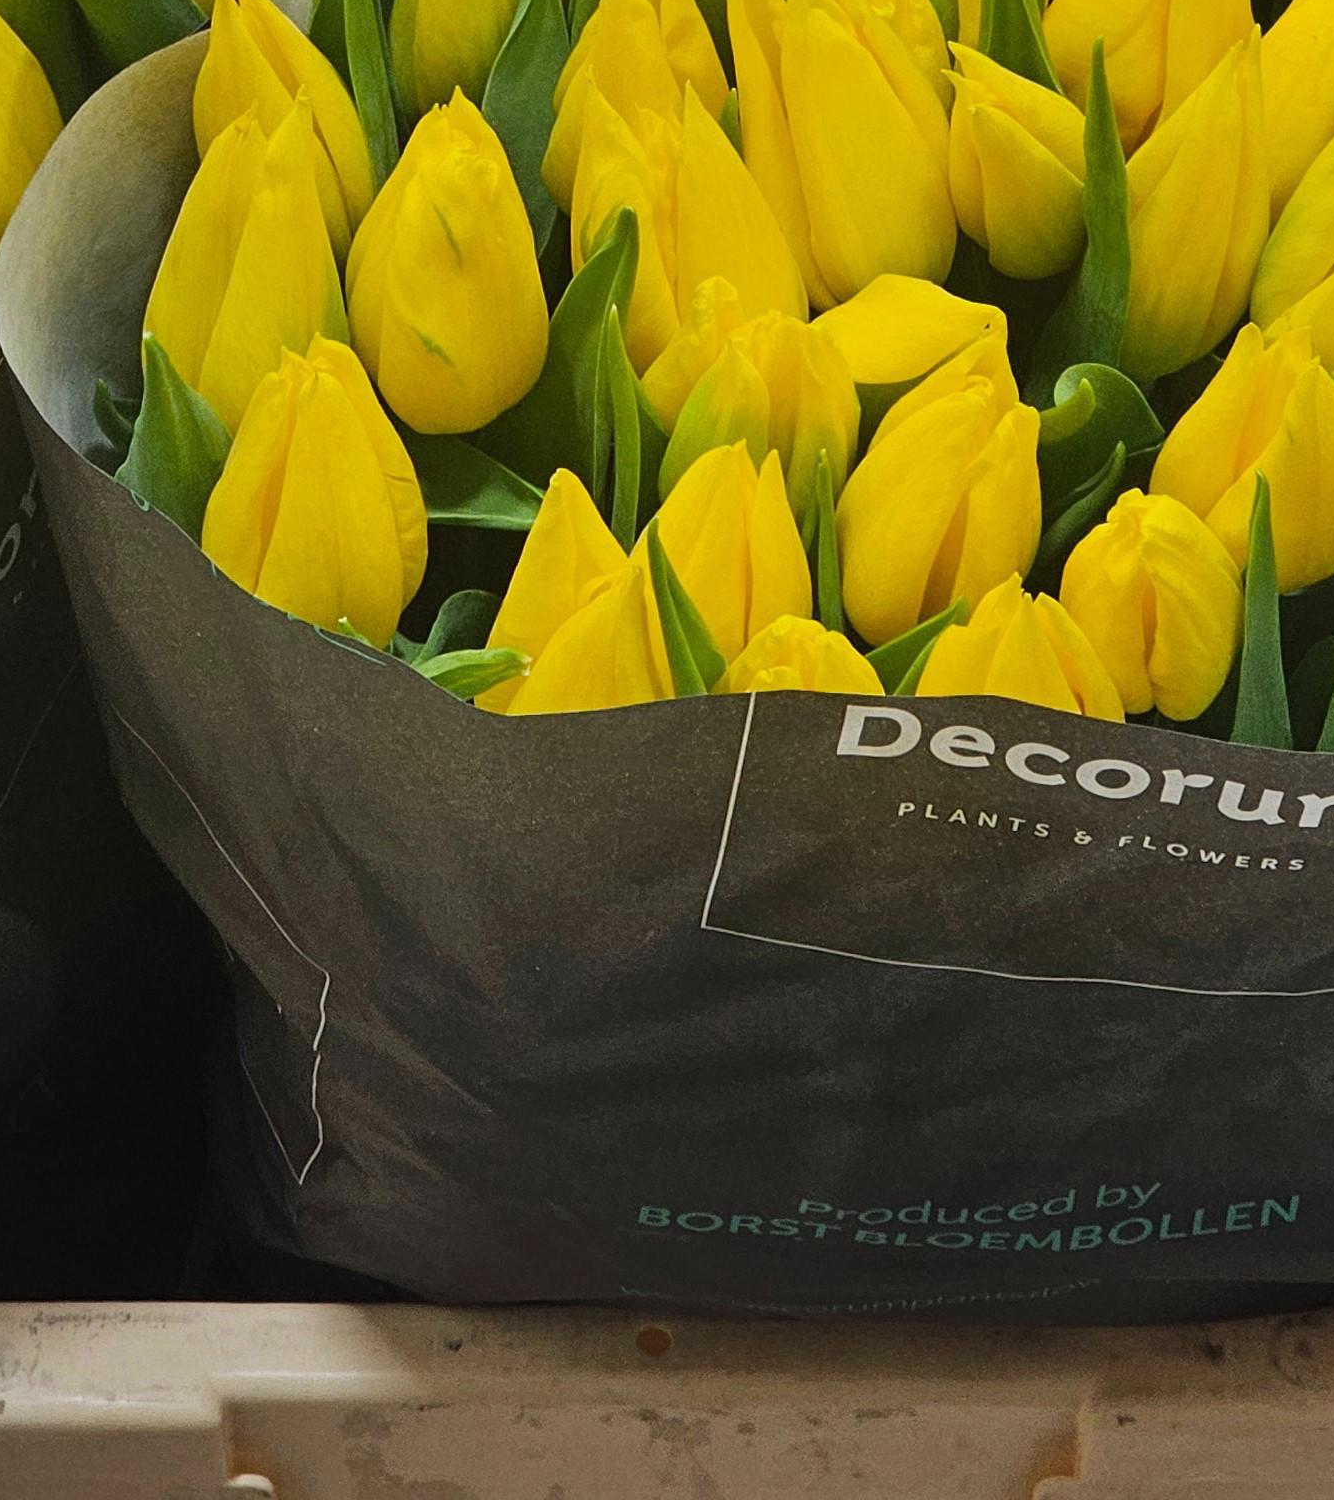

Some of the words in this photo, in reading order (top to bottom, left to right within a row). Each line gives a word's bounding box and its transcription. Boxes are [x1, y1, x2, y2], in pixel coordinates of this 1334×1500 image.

[897, 802, 1051, 839] PLANTS
[1072, 829, 1093, 847] &
[1117, 835, 1308, 873] FLOWERS
[636, 1204, 845, 1238] BORST
[854, 1195, 1301, 1253] BLOEMBOLLEN
[798, 1188, 1076, 1225] Produced
[1096, 1180, 1162, 1209] by
